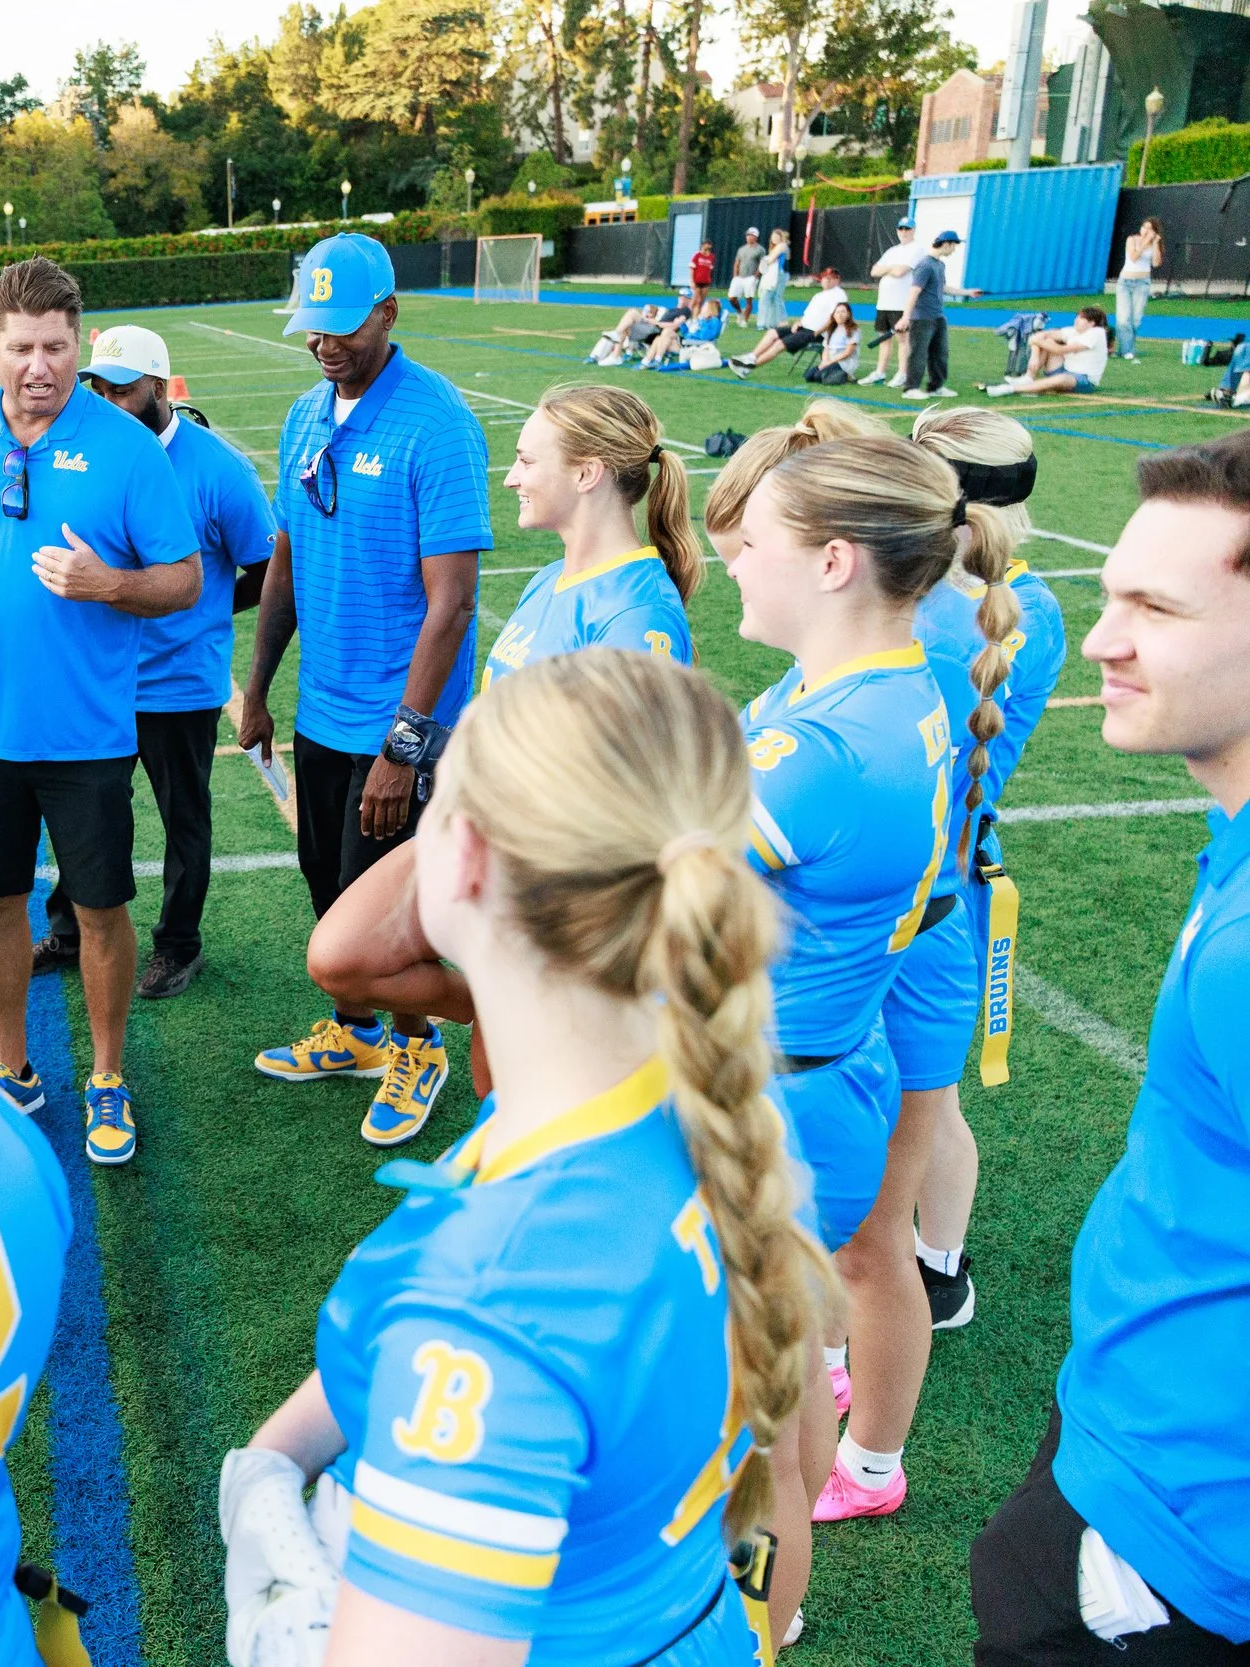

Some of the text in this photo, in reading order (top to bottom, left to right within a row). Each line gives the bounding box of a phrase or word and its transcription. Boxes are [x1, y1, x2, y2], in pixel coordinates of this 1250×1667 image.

[309, 267, 333, 303] B
[52, 449, 89, 473] Ucla
[352, 451, 384, 477] Ucla
[988, 936, 1012, 1036] BRUINS
[391, 1339, 494, 1465] B
